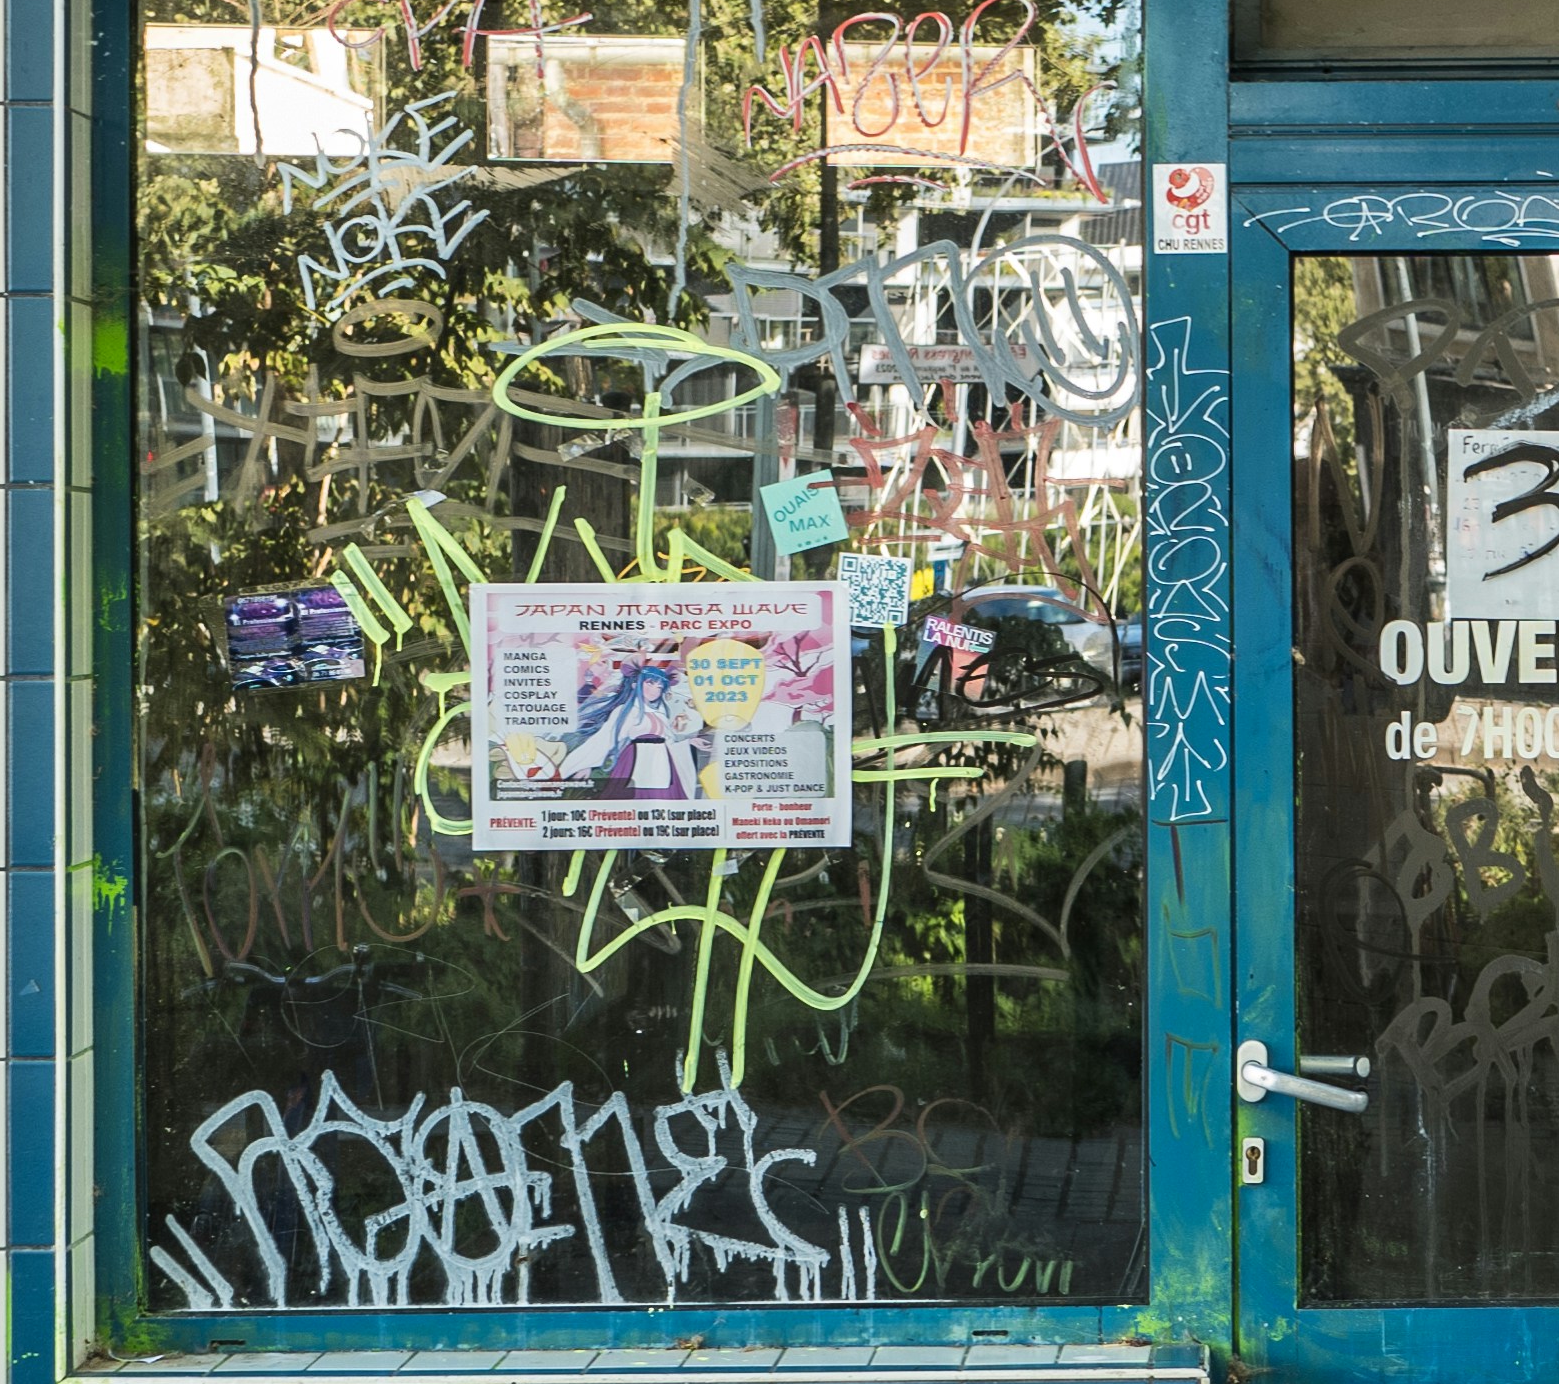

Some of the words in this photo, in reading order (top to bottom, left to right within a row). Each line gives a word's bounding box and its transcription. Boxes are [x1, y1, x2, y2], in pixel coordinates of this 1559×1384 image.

[1172, 209, 1211, 235] cgt
[1158, 239, 1180, 250] CHU
[1183, 238, 1224, 250] RENNES
[774, 487, 819, 524] OUAIS
[788, 514, 832, 533] MAX
[515, 604, 605, 617] JAPAN
[617, 603, 723, 617] MANGA
[733, 603, 808, 615] WAVE
[579, 621, 645, 631] RENNES
[660, 620, 702, 630] PARC
[708, 620, 752, 630] EXPO
[926, 616, 994, 645] RALENTIS
[922, 629, 941, 643] LA
[944, 633, 981, 653] NUIT
[504, 652, 547, 661] MANGA
[690, 659, 711, 670] 30
[717, 658, 762, 670] SEPT
[504, 665, 550, 674] COMICS
[504, 678, 551, 687] INVITES
[694, 675, 714, 686] 01
[721, 674, 759, 686] OCT
[504, 691, 557, 700] COSPLAY
[705, 691, 748, 703] 2023
[505, 703, 567, 713] TATOUAGE
[505, 716, 569, 726] TRADITION
[724, 734, 775, 743] CONCERTS
[1385, 711, 1438, 761] de
[724, 746, 749, 755] JEUX
[752, 746, 787, 755] VIDEOS
[724, 759, 788, 768] EXPOSITIONS
[724, 771, 794, 780] GASTRONOMIE
[724, 784, 753, 793] K-POP
[756, 784, 763, 793] &
[766, 784, 791, 793] JUST
[793, 783, 825, 792] DANCE
[779, 802, 812, 811] bonheur
[541, 810, 546, 821] 1
[638, 810, 649, 820] ou
[732, 817, 760, 826] Maneki
[763, 817, 781, 826] Neko
[795, 816, 831, 825] Omamori
[542, 826, 548, 838] 2
[643, 826, 654, 836] ou
[760, 831, 778, 839] avec
[779, 830, 787, 839] la
